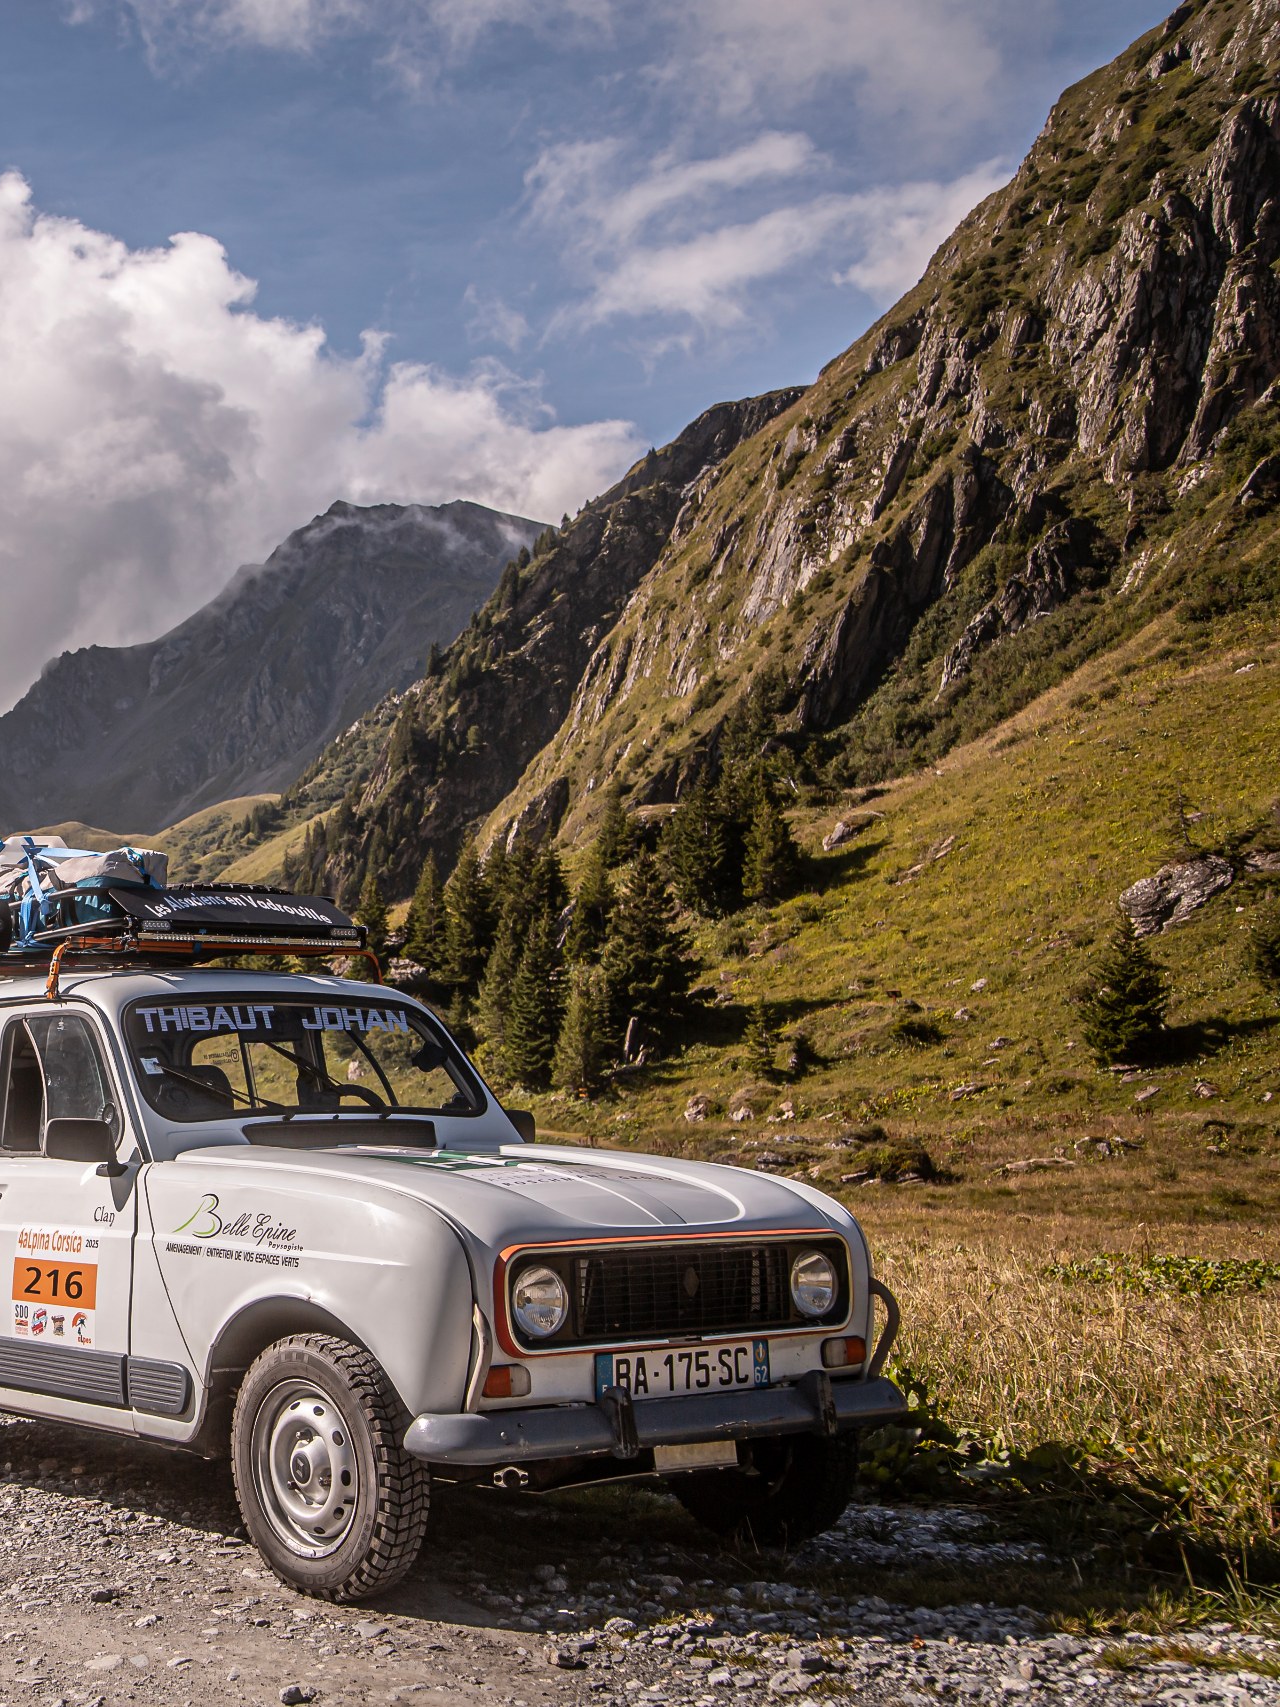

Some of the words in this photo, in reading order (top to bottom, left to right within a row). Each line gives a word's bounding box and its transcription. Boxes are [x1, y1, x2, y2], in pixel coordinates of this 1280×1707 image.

[144, 903, 171, 918] Les
[163, 893, 227, 912] Alsaciens
[224, 896, 247, 907] en
[239, 894, 334, 925] Vadrouille
[135, 1005, 275, 1033] THIBAUT
[302, 1006, 410, 1033] JOHAN
[93, 1206, 116, 1228] Clan
[171, 1193, 251, 1239] Belle
[252, 1213, 297, 1246] Epine
[51, 1230, 82, 1253] Corsica
[85, 1239, 99, 1249] 2025
[267, 1240, 304, 1252] Paysagiste
[165, 1242, 203, 1256] AMENAGEMENT
[206, 1248, 234, 1261] ENTRETIEN
[234, 1250, 243, 1261] DE
[243, 1251, 254, 1263] VOS
[255, 1253, 280, 1266] ESPACES
[281, 1255, 299, 1268] VERTS
[23, 1266, 83, 1300] 216
[14, 1304, 29, 1319] SDO
[754, 1365, 768, 1383] 62
